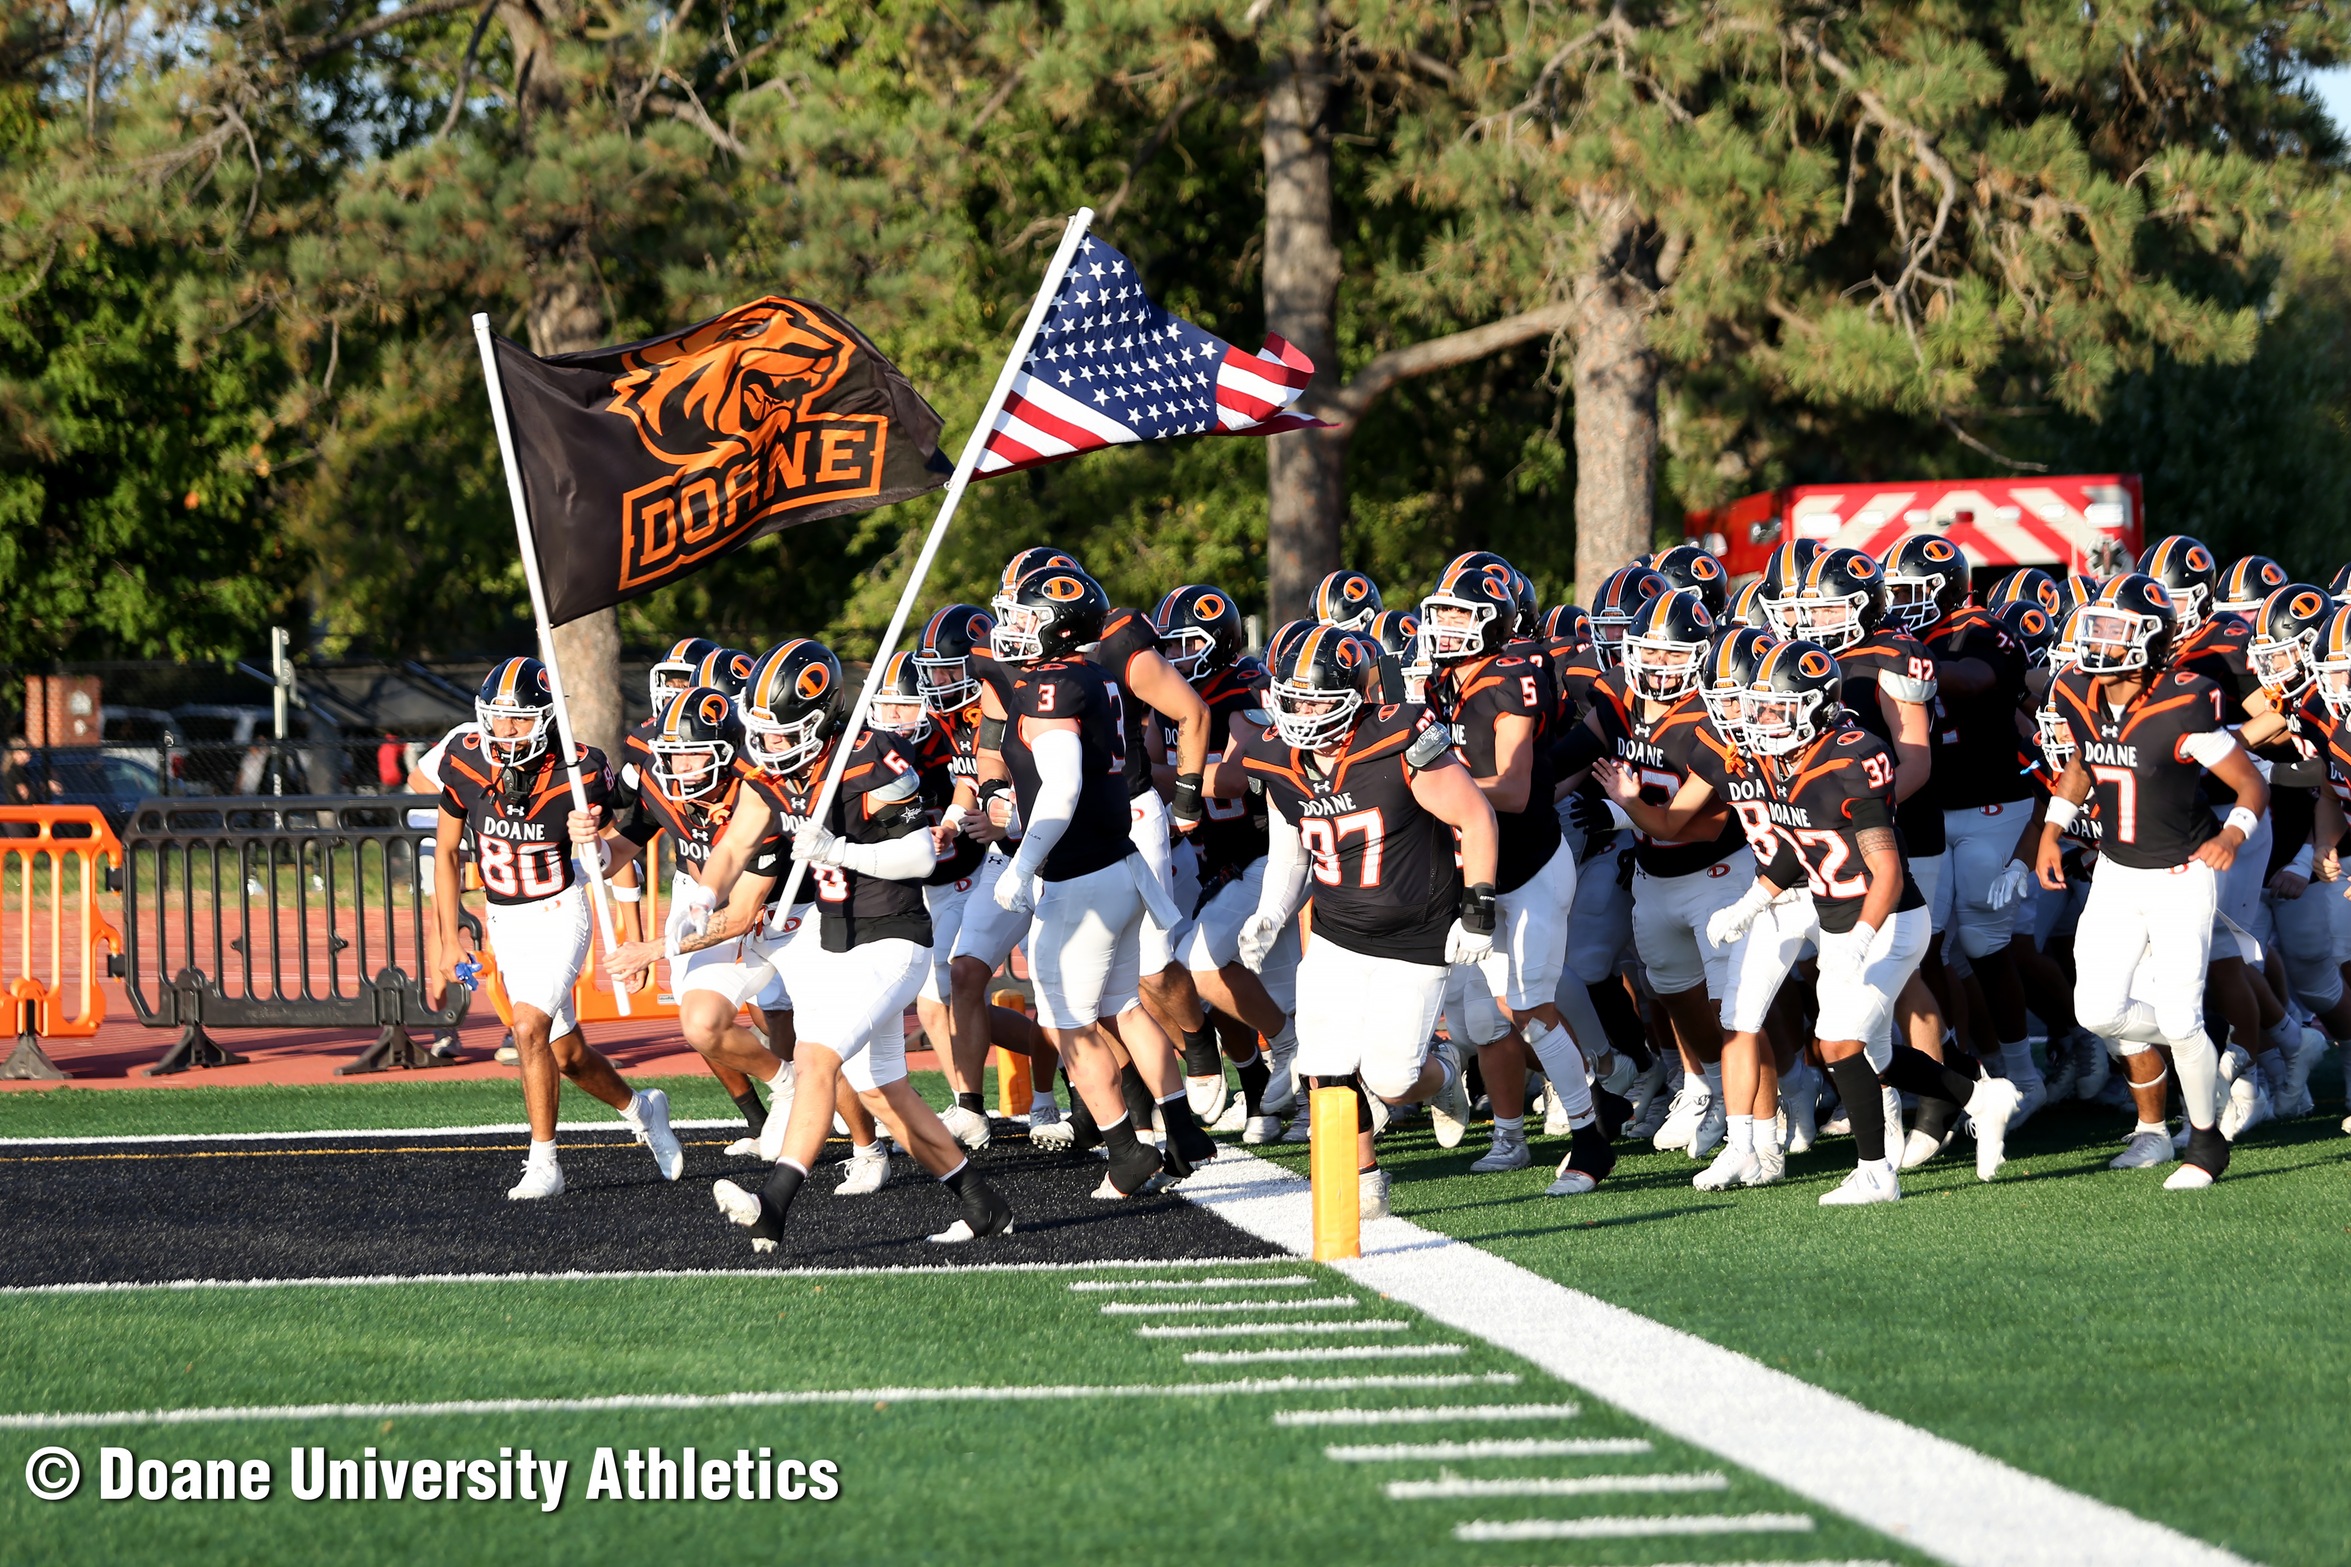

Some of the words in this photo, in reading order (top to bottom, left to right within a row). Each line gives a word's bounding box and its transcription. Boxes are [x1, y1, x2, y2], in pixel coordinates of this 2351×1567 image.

[639, 429, 866, 567] DOANE
[1037, 683, 1056, 712] 3
[1520, 675, 1538, 707] 5
[2208, 688, 2222, 721] 7
[1617, 736, 1665, 769] DOANE
[2084, 740, 2138, 767] DOANE
[1862, 751, 1895, 790] 32
[1298, 792, 1357, 817] DOANE
[1727, 778, 1766, 801] DOA
[2091, 764, 2137, 844] 7
[484, 817, 545, 841] DOANE
[1768, 801, 1812, 828] DOANE
[678, 838, 712, 861] DOA
[1300, 806, 1385, 888] 97
[478, 832, 565, 899] 80
